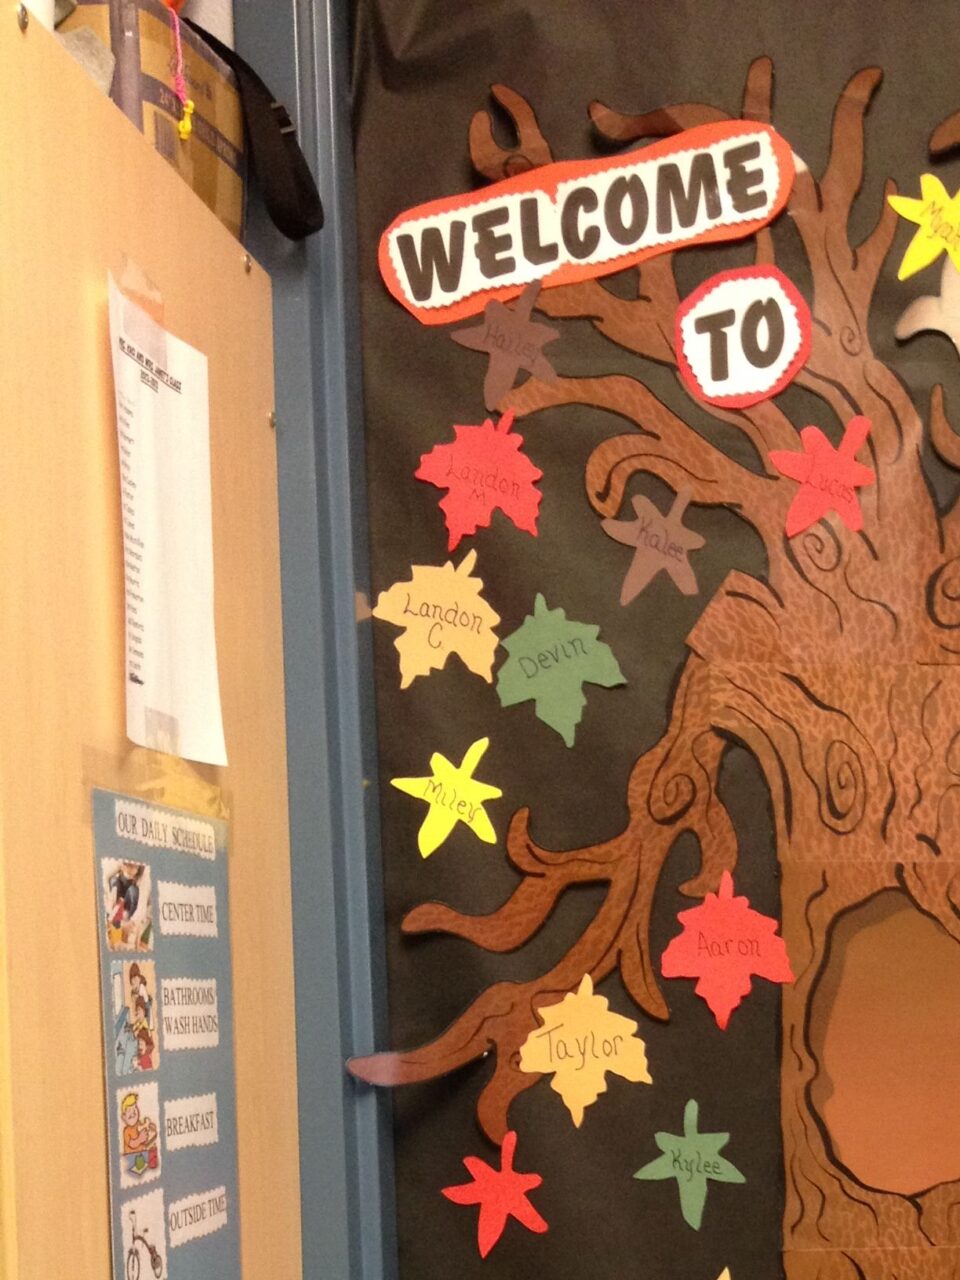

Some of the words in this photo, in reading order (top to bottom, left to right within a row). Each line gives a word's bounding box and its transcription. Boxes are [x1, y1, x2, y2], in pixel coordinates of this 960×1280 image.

[396, 141, 768, 302] WELCOME
[695, 297, 785, 382] TO
[445, 454, 520, 500] Landon
[403, 593, 484, 635] Landon
[518, 637, 588, 679] Devin
[425, 779, 478, 824] Miley
[117, 811, 137, 835] OUR
[141, 820, 168, 844] DAILY
[171, 825, 215, 854] SCHEDULE
[162, 901, 194, 923] CENTER
[195, 903, 214, 925] TIME
[697, 934, 762, 958] Aaron
[164, 1015, 190, 1035] WASH
[191, 1014, 218, 1034] HANDS
[537, 1024, 624, 1071] Taylor
[166, 1110, 214, 1137] BREAKFAST
[671, 1149, 724, 1183] Kylee
[170, 1198, 207, 1231] OUTSIDE
[208, 1194, 226, 1218] TIME
